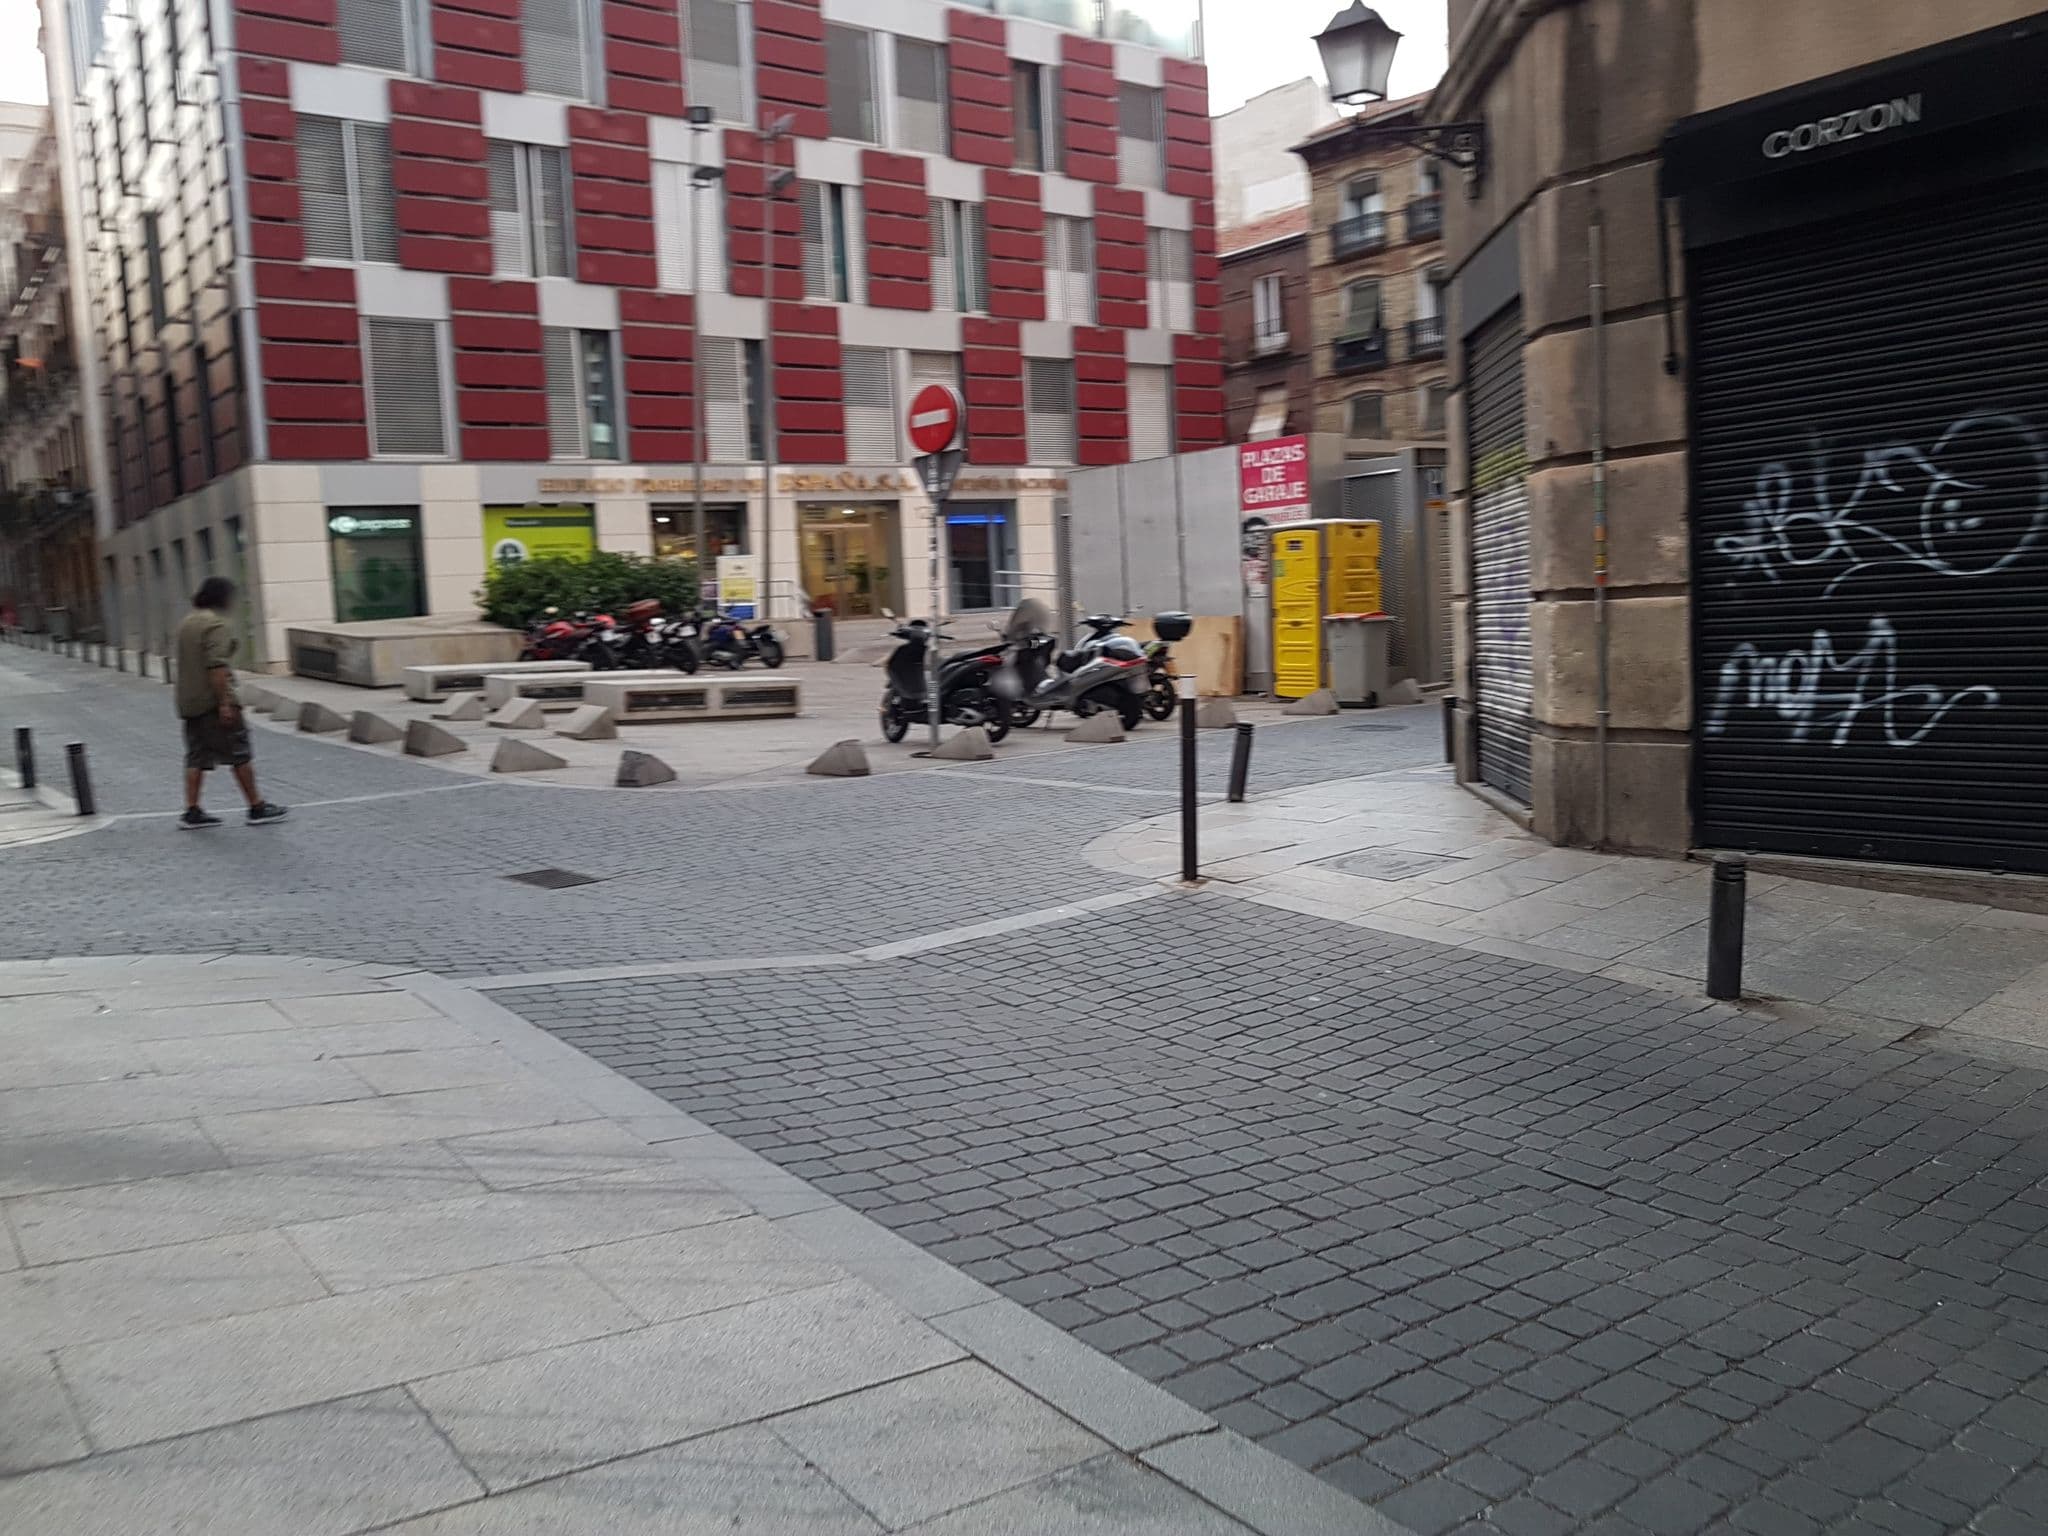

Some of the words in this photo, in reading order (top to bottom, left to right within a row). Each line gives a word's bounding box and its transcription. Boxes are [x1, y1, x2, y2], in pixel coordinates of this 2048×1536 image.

[1762, 93, 1922, 158] CORZON
[1242, 444, 1306, 469] PLAZAS
[1261, 466, 1286, 484] DE
[1243, 481, 1308, 504] GARAJE
